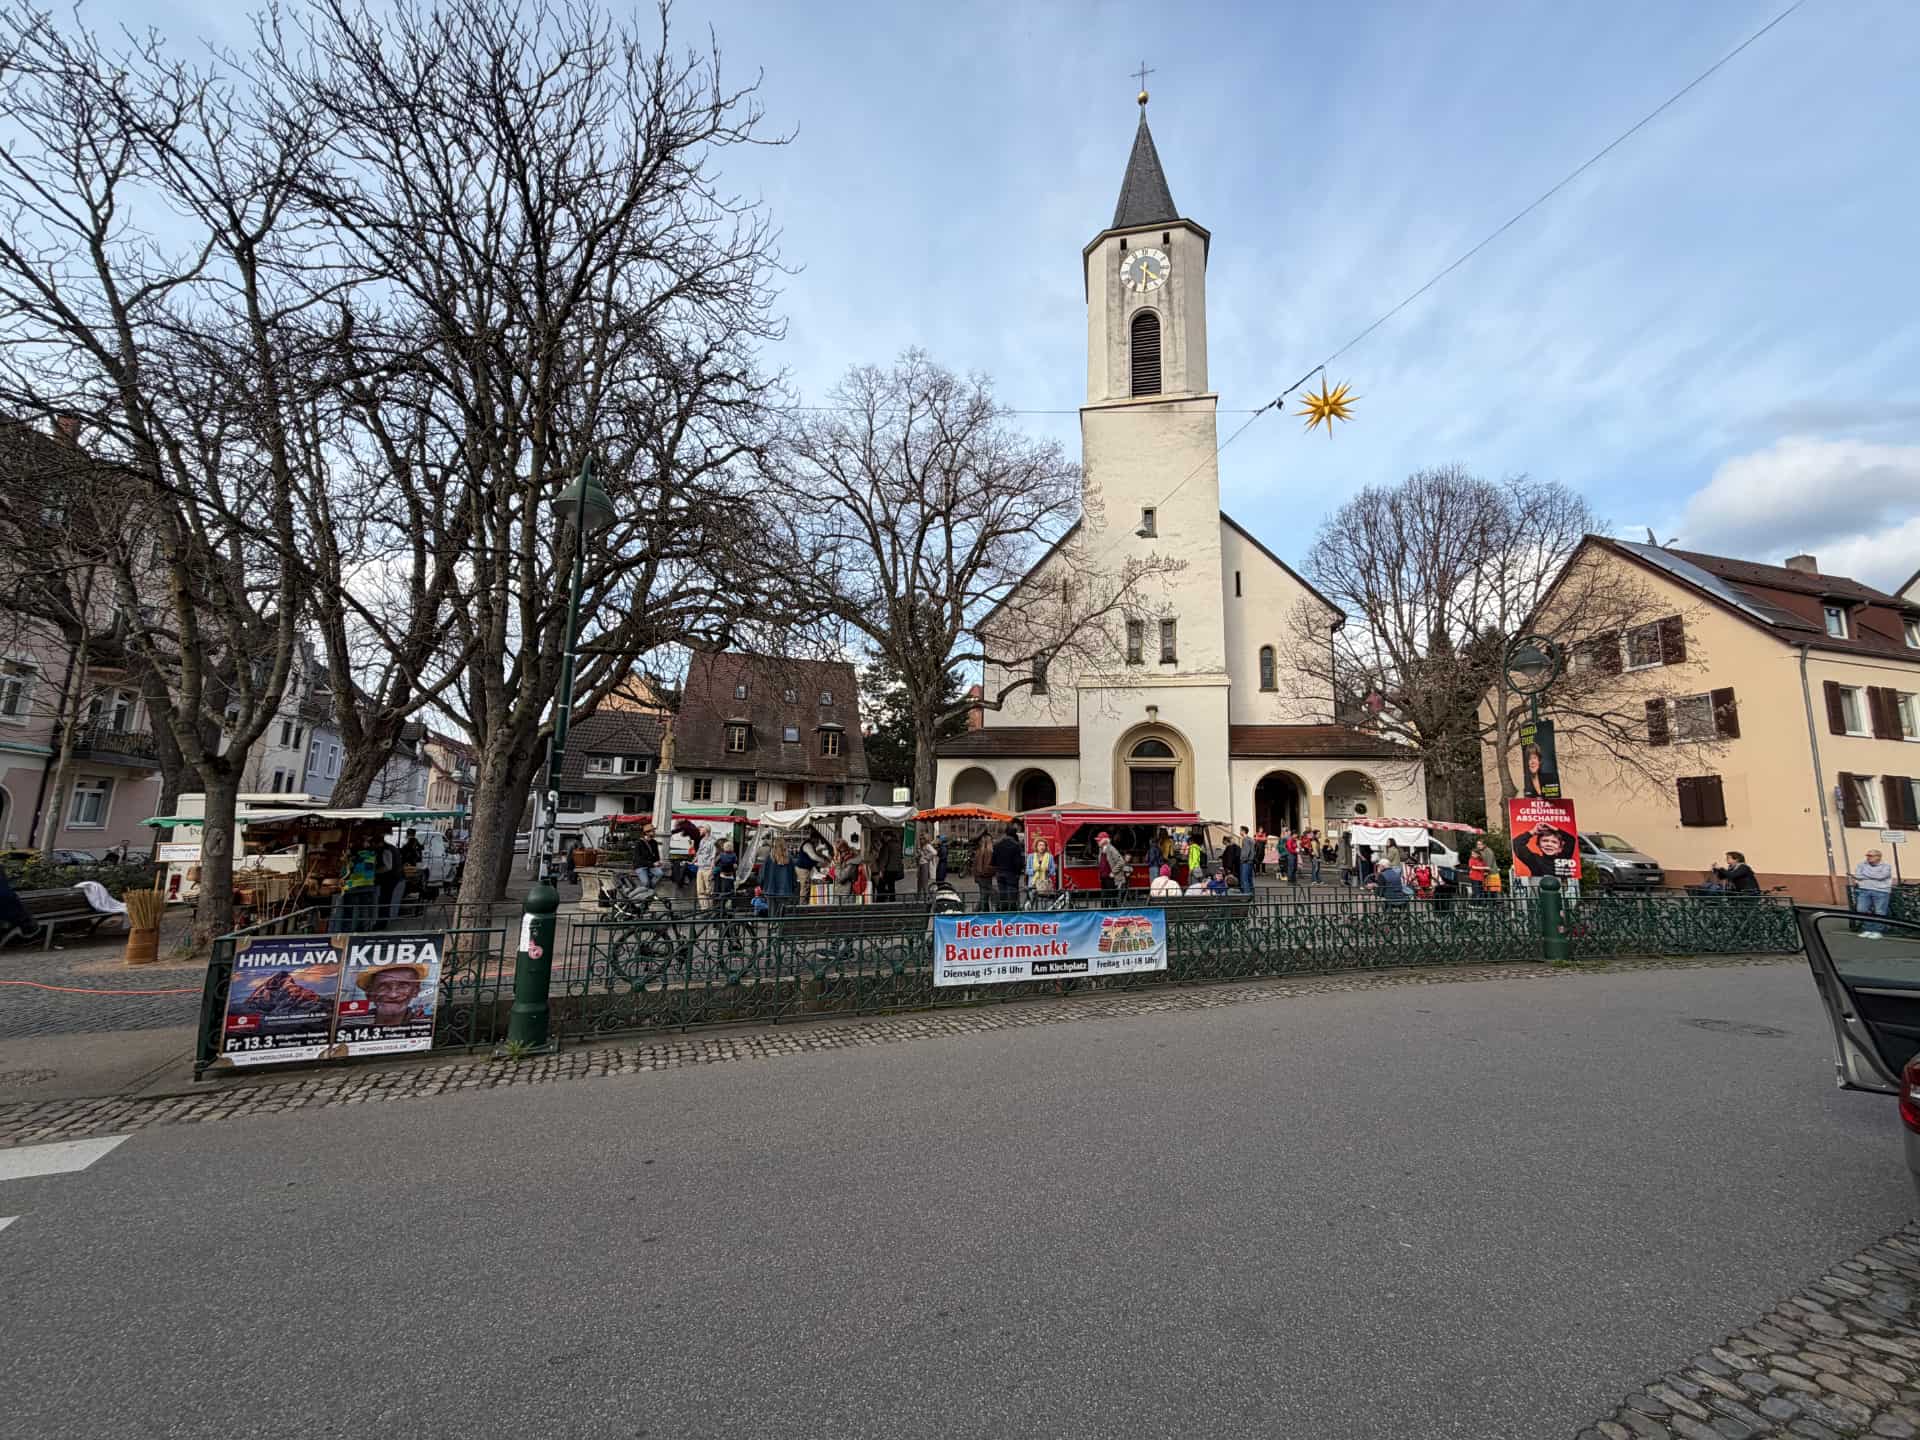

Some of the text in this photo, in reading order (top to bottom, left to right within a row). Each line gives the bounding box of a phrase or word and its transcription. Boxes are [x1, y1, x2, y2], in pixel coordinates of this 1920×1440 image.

[1520, 807, 1566, 815] GEBÜHREN
[1516, 815, 1571, 823] ABSCHAFFEN
[1554, 858, 1577, 868] SPD
[956, 919, 1059, 938] Herdermer
[349, 942, 438, 966] KUBA
[944, 940, 1069, 961] Bauernmarkt
[239, 950, 338, 967] HIMALAYA
[1096, 959, 1120, 969] Freitag
[1144, 956, 1158, 965] Uhr
[944, 967, 980, 978] Dienstag
[1009, 965, 1024, 974] Uhr
[1033, 961, 1087, 973] Am Kirchplatz
[336, 1030, 352, 1043] Sa
[354, 1027, 384, 1041] 14.3.
[226, 1035, 276, 1051] Fr 13.3.
